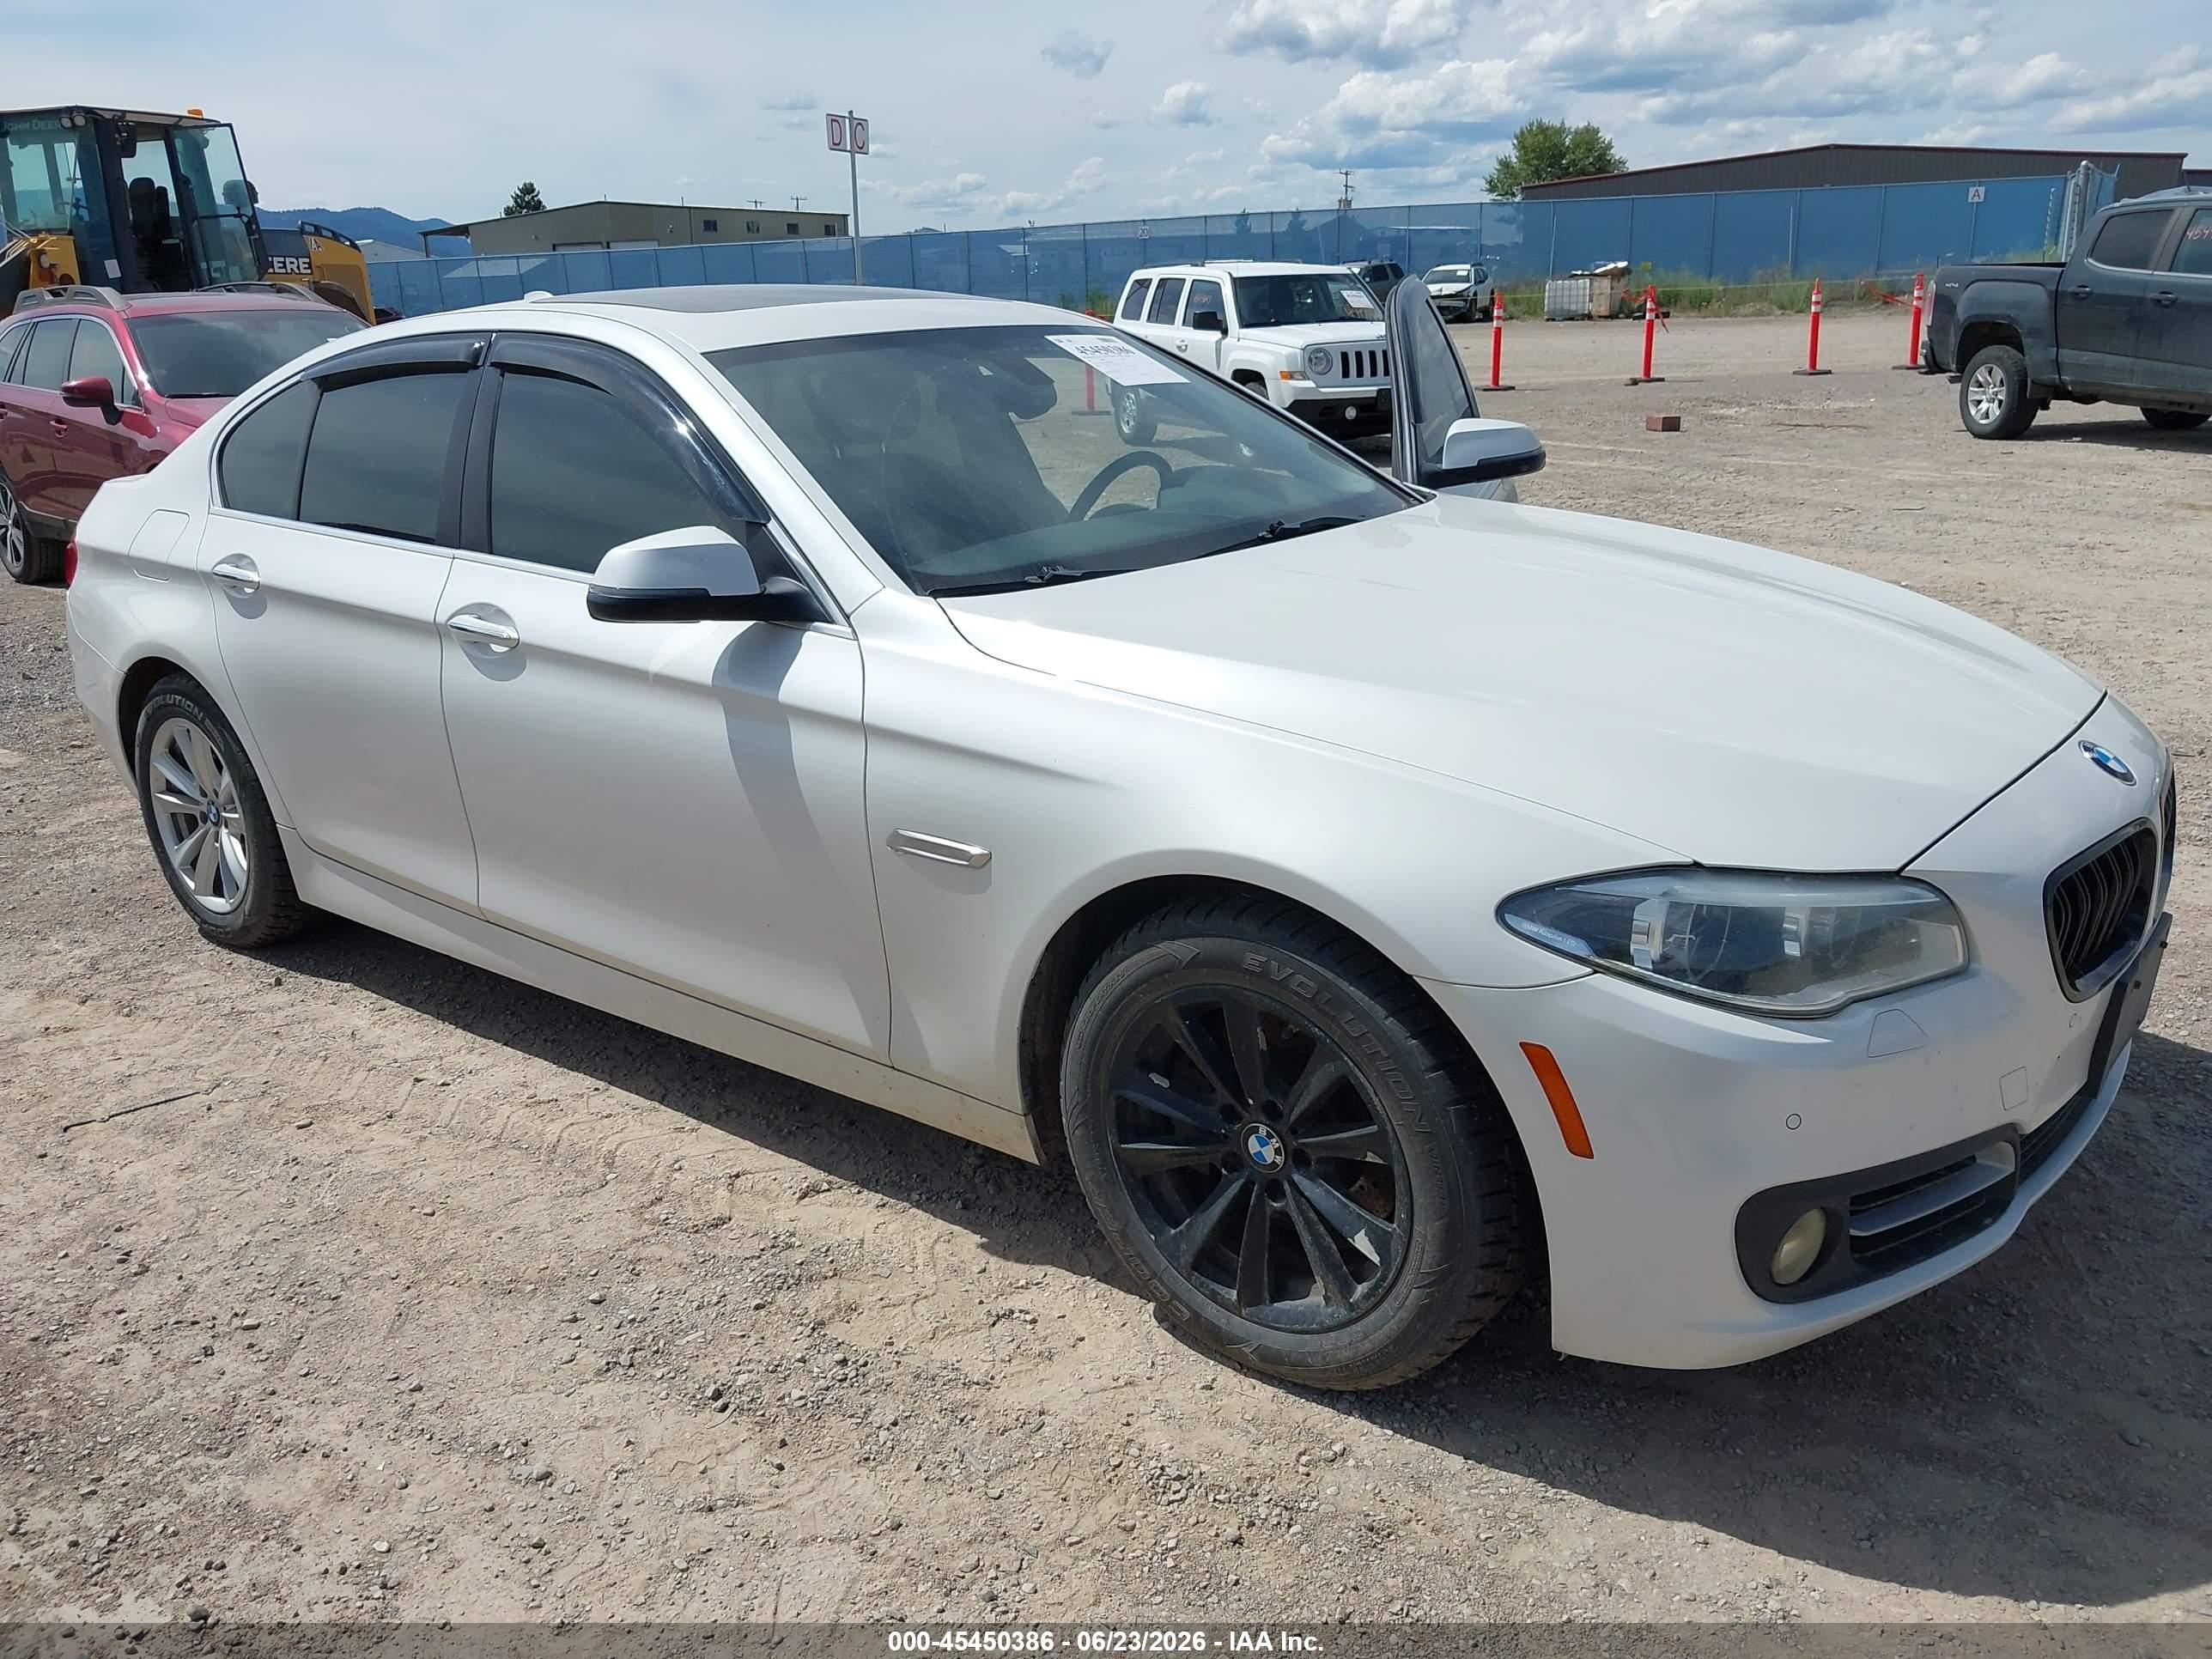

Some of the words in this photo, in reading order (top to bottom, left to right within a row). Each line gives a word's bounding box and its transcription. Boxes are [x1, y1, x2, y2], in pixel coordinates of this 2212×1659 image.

[1, 120, 31, 131] JOHN
[33, 119, 63, 131] DEER
[830, 118, 842, 146] D
[854, 122, 866, 149] C
[1971, 188, 1981, 200] A
[1564, 938, 1577, 946] LED
[1243, 951, 1432, 1133] EVOLUTION
[1258, 1126, 1284, 1164] BMW
